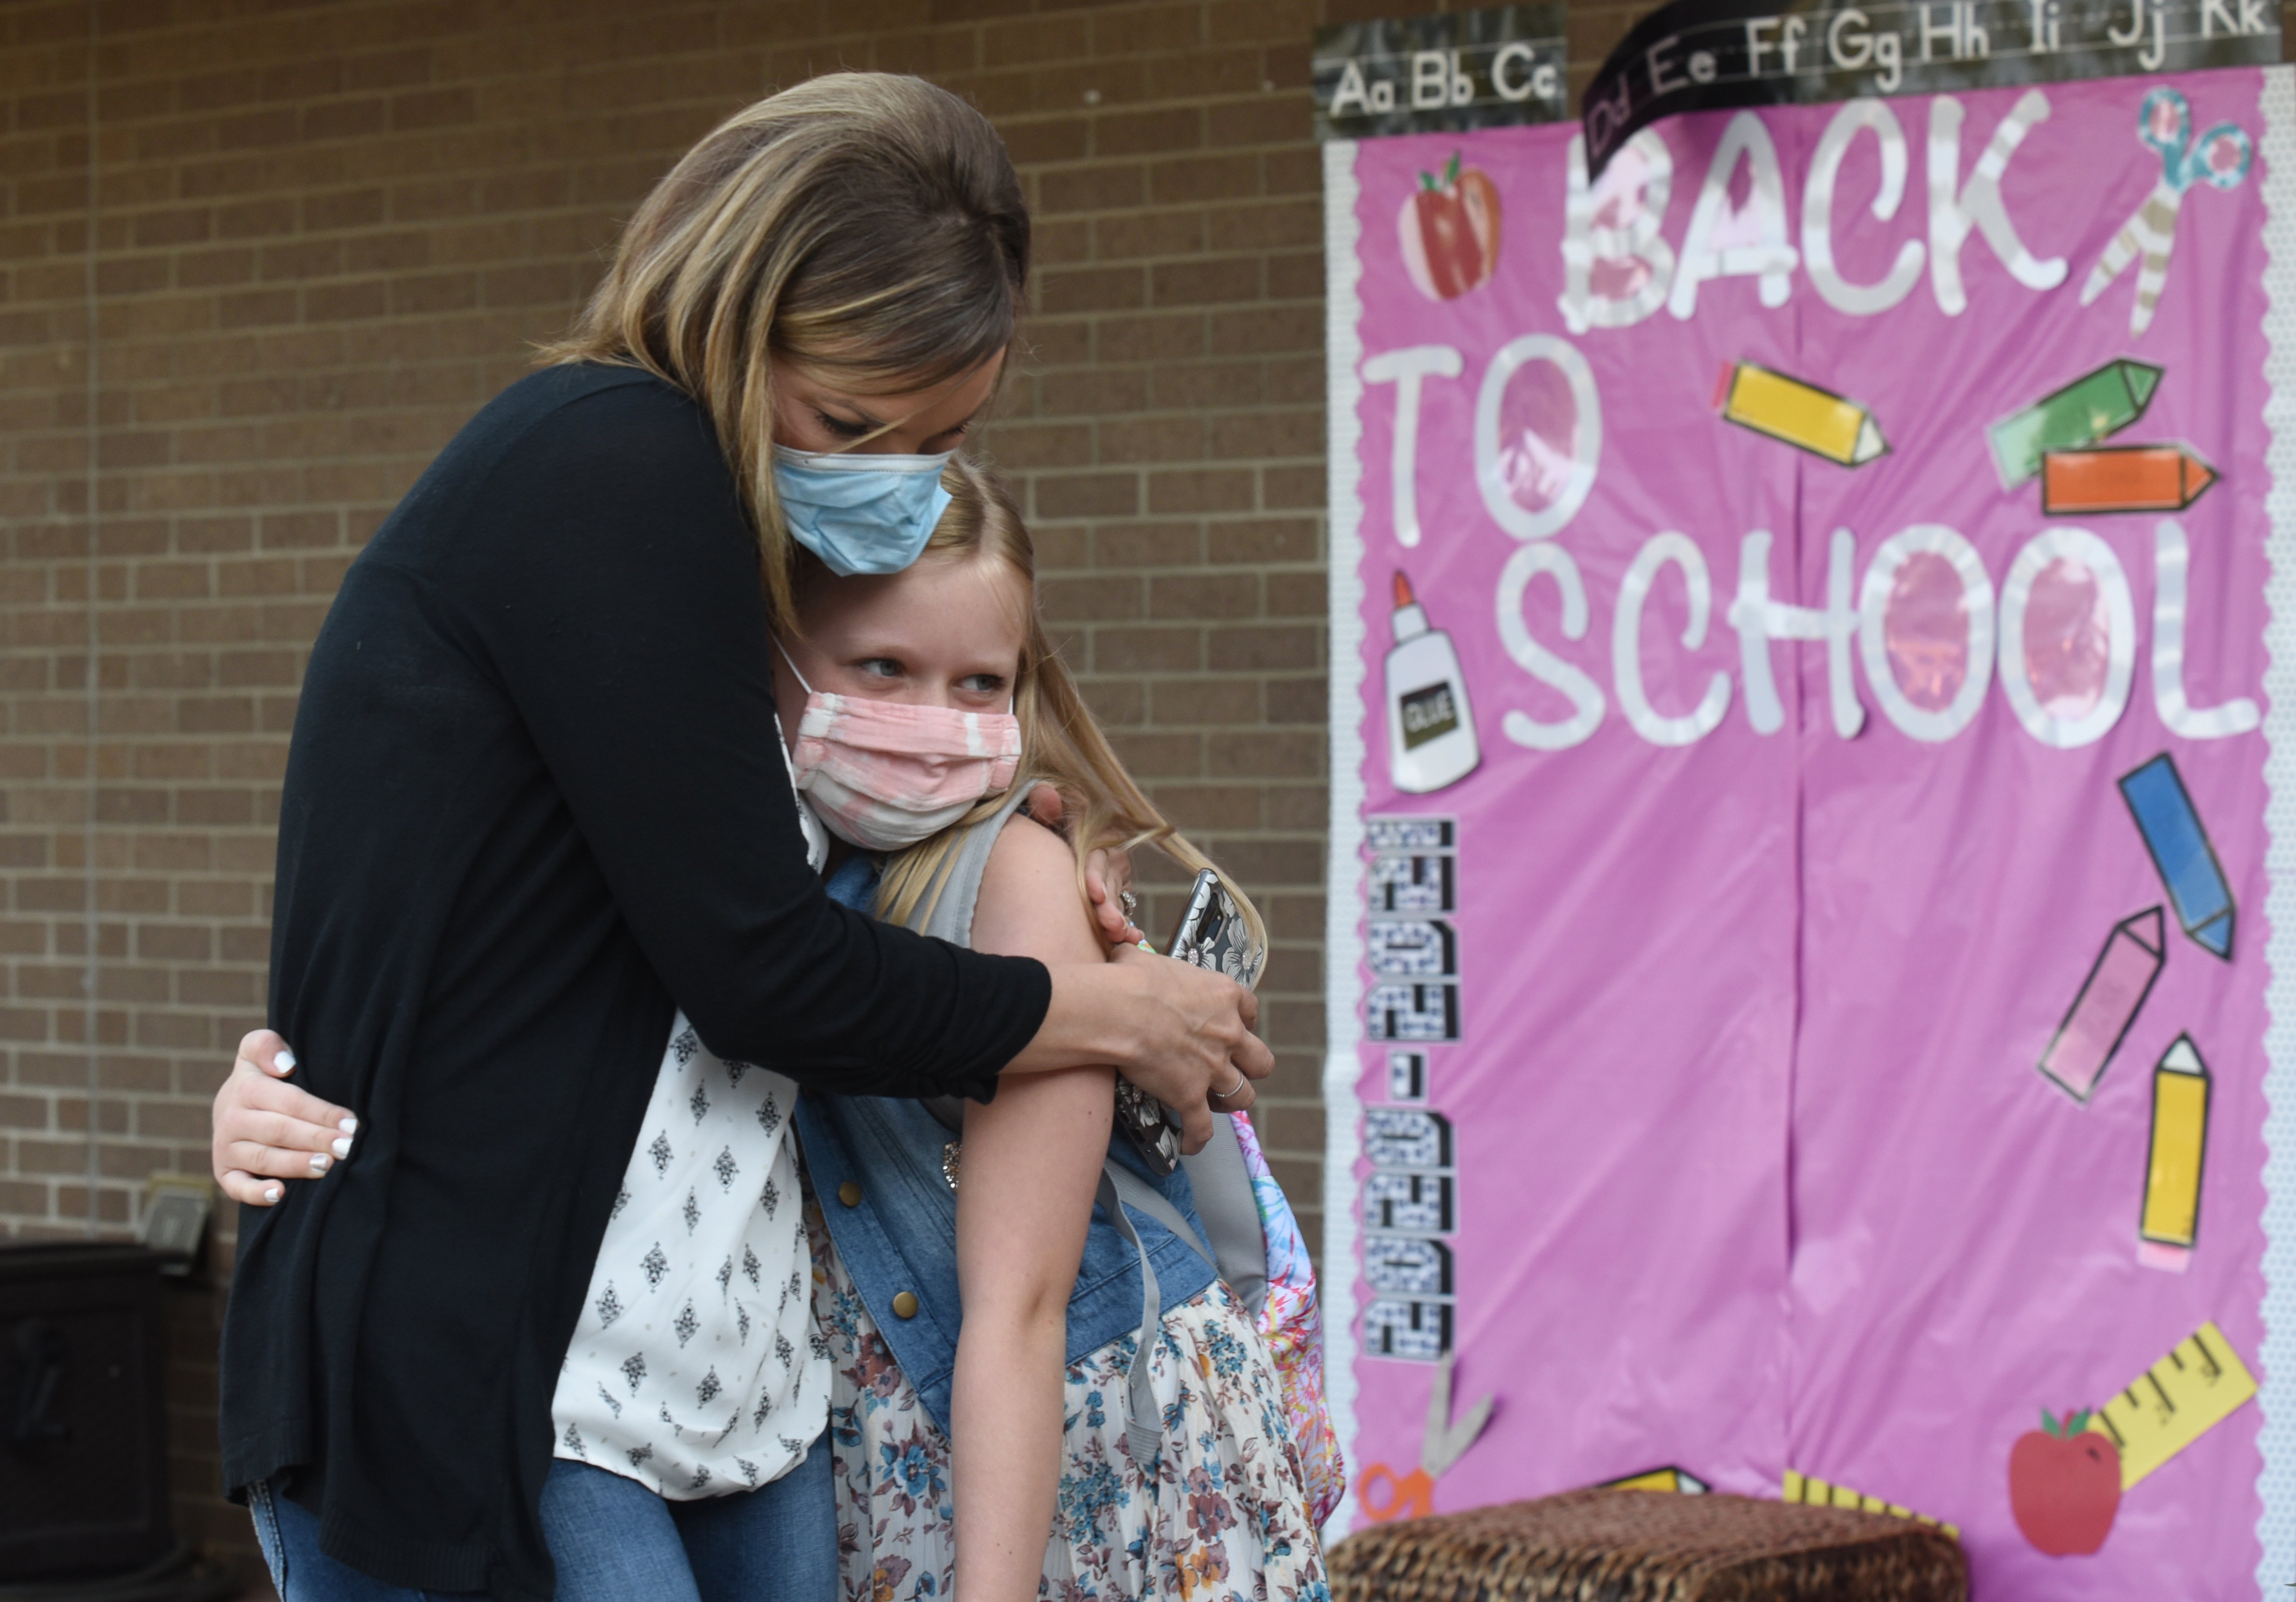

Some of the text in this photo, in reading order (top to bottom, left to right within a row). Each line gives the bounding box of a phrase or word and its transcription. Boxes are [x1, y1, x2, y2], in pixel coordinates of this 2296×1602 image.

[1330, 43, 1558, 116] Aa Bb Cc
[1587, 0, 2266, 157] Dd Ee Ff Gg Hh Ii Jj Kk
[1558, 90, 2069, 334] BACK
[1361, 333, 1602, 548] TO
[1495, 520, 2260, 749] SCHOOL
